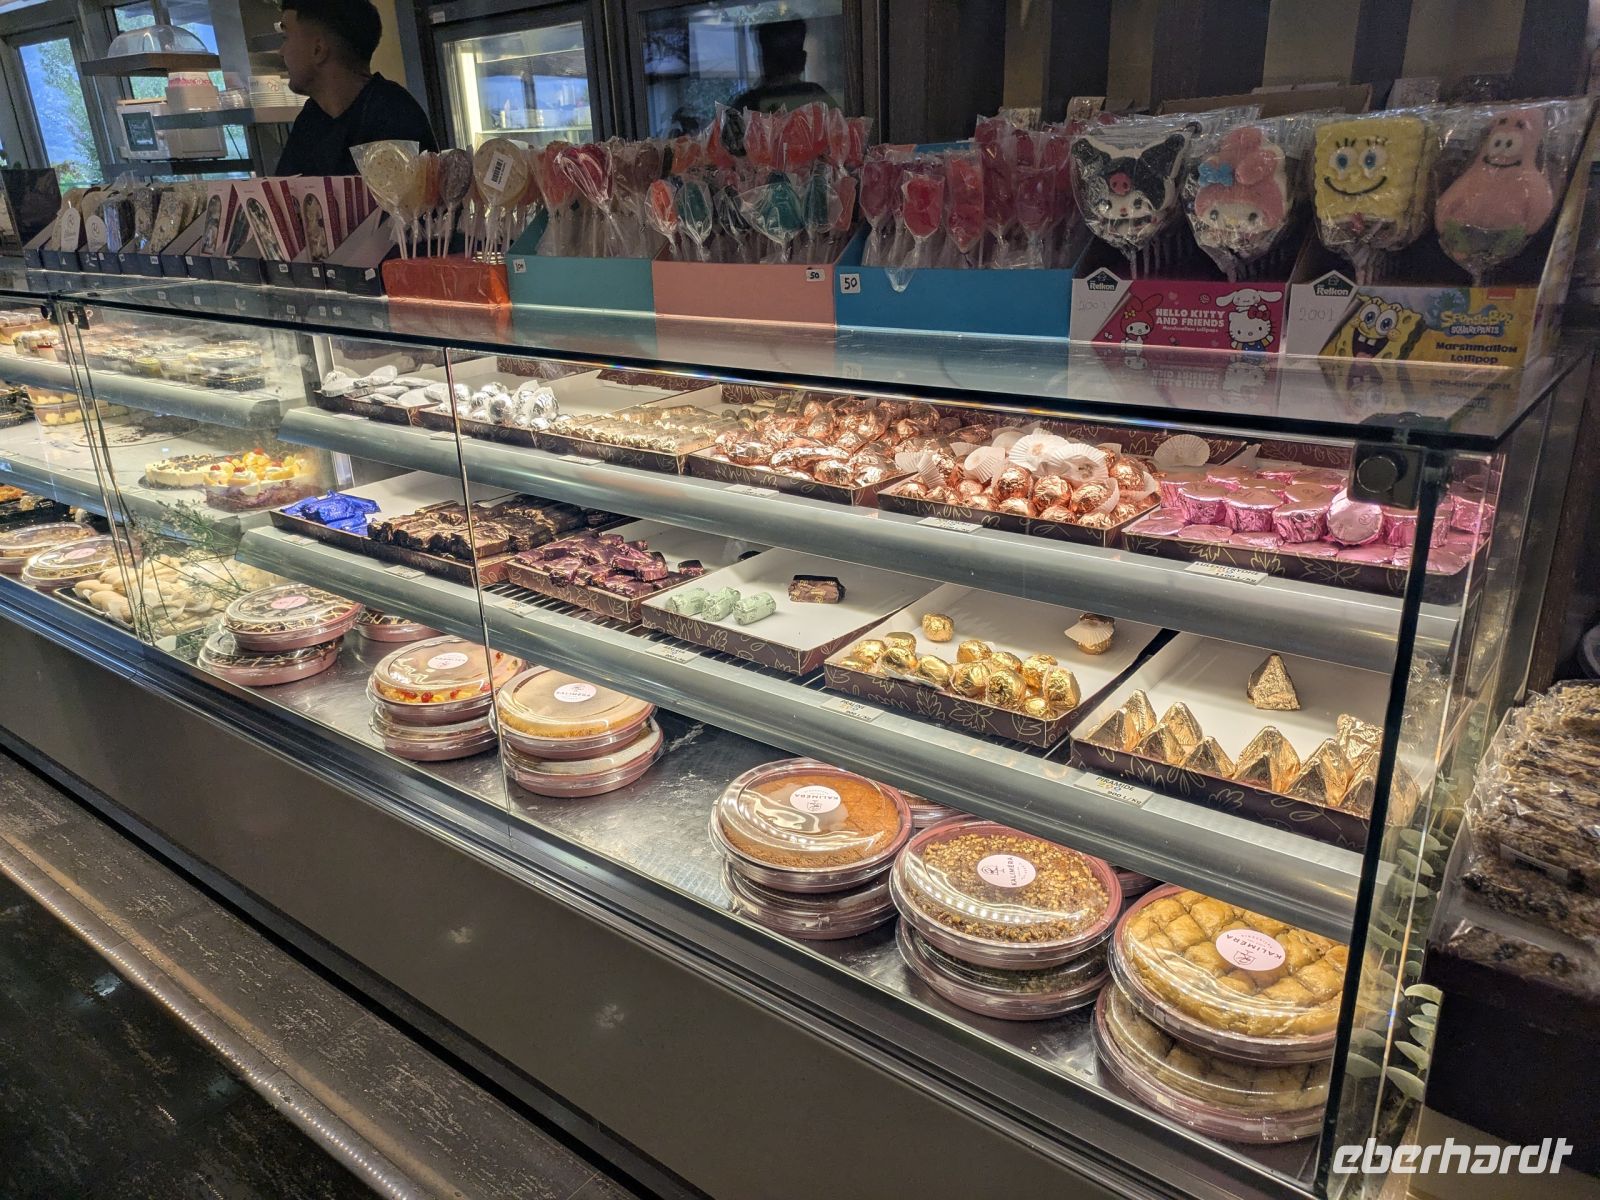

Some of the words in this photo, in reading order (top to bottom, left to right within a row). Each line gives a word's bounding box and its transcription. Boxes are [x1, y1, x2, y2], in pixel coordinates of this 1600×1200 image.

[809, 271, 820, 279] 50
[844, 277, 858, 290] 50
[1089, 282, 1115, 290] Relkon
[1316, 287, 1349, 296] Relkon
[1155, 308, 1188, 317] HELLO
[1190, 309, 1226, 319] KITTY
[1155, 317, 1178, 325] AND
[1181, 318, 1225, 327] FRIENDS
[1450, 325, 1499, 335] SQUAREPANTS
[1435, 341, 1518, 353] Marshmallow
[1450, 354, 1498, 364] Lollipop
[1096, 776, 1136, 791] PIRAMIDE
